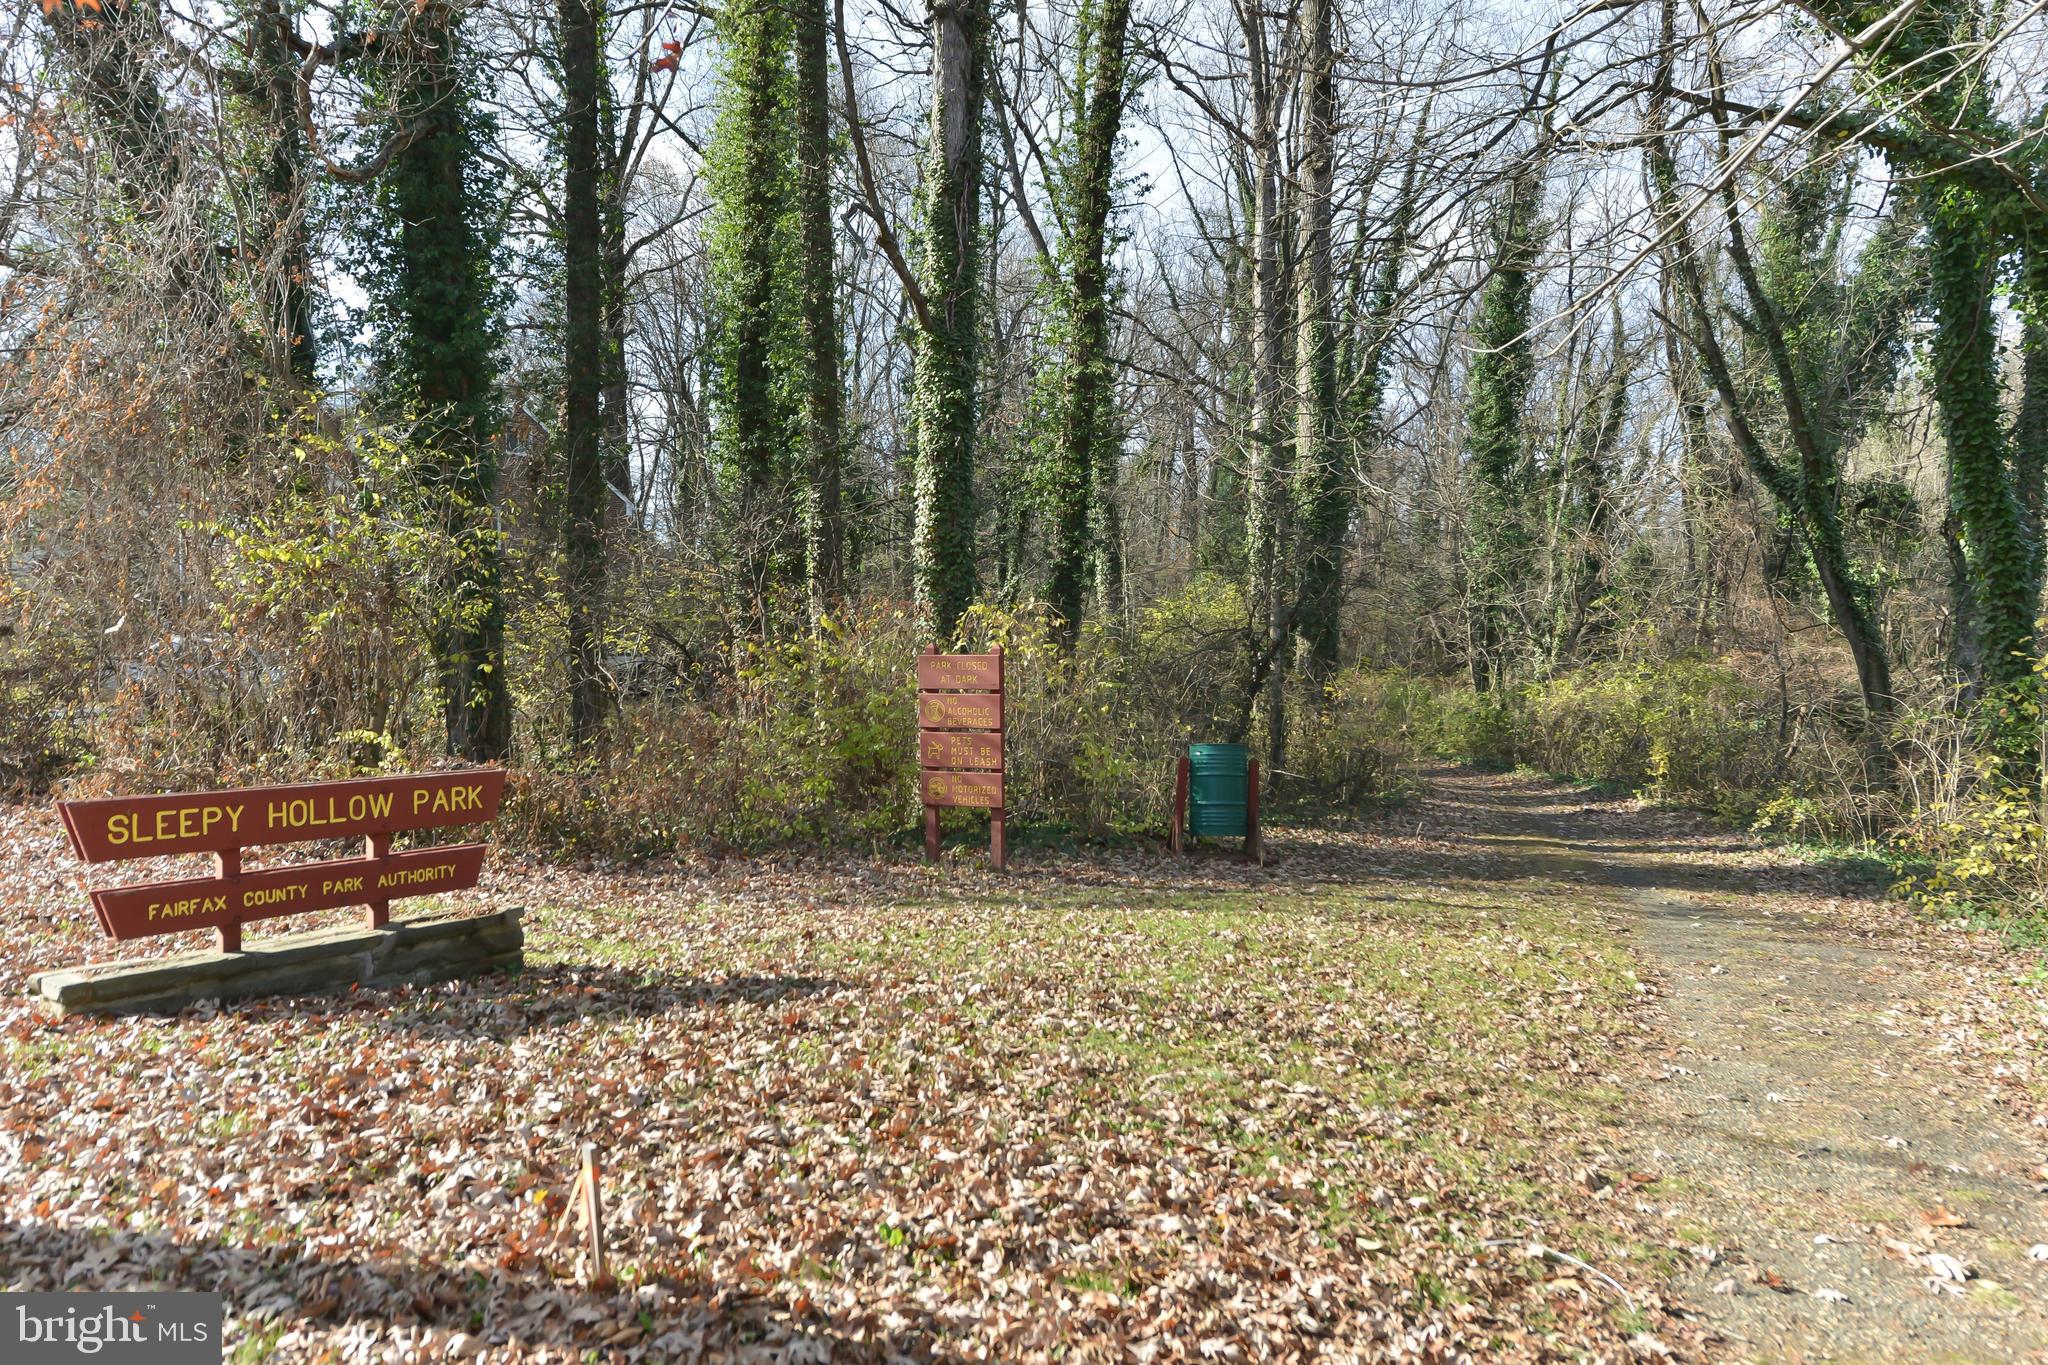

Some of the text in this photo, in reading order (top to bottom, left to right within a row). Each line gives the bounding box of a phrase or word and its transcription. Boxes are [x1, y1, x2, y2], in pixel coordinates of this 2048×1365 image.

[930, 661, 988, 671] PARK CLOSED
[940, 675, 978, 684] AT DARK
[947, 707, 990, 716] ALCOHOLIC
[947, 717, 993, 726] BEVERAGES
[951, 737, 972, 745] PETS
[951, 747, 991, 756] MUST BE
[951, 757, 997, 766] ON LEASH
[951, 775, 962, 783] NO
[951, 785, 997, 794] MOTORIZED
[952, 795, 990, 805] VEHICLES
[107, 785, 484, 845] SLEEPY HOLLOW PARK
[148, 864, 457, 921] FAIRFAX COUNTY PARK AUTHORITY
